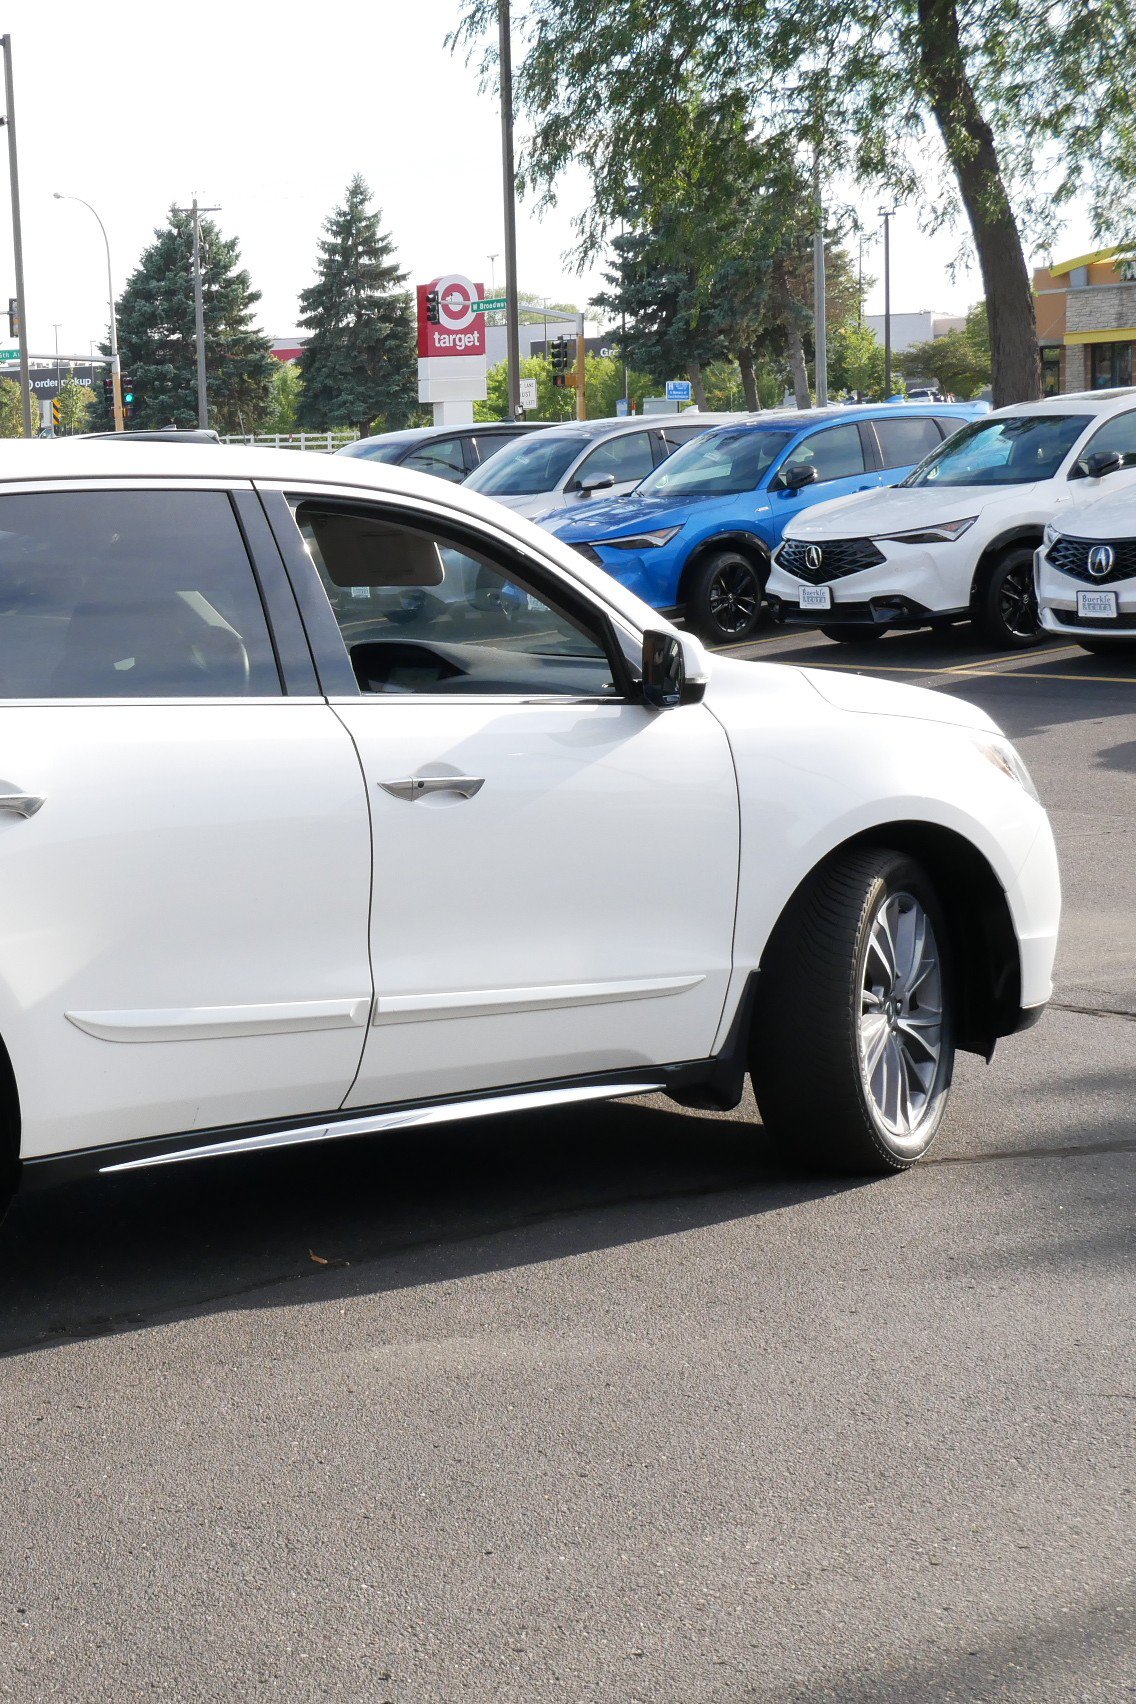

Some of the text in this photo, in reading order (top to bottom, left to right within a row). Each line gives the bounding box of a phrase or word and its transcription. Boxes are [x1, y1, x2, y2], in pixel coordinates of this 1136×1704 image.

[472, 303, 478, 311] W
[433, 330, 480, 350] target
[34, 377, 92, 389] order pkup
[1082, 594, 1111, 603] Buerkle
